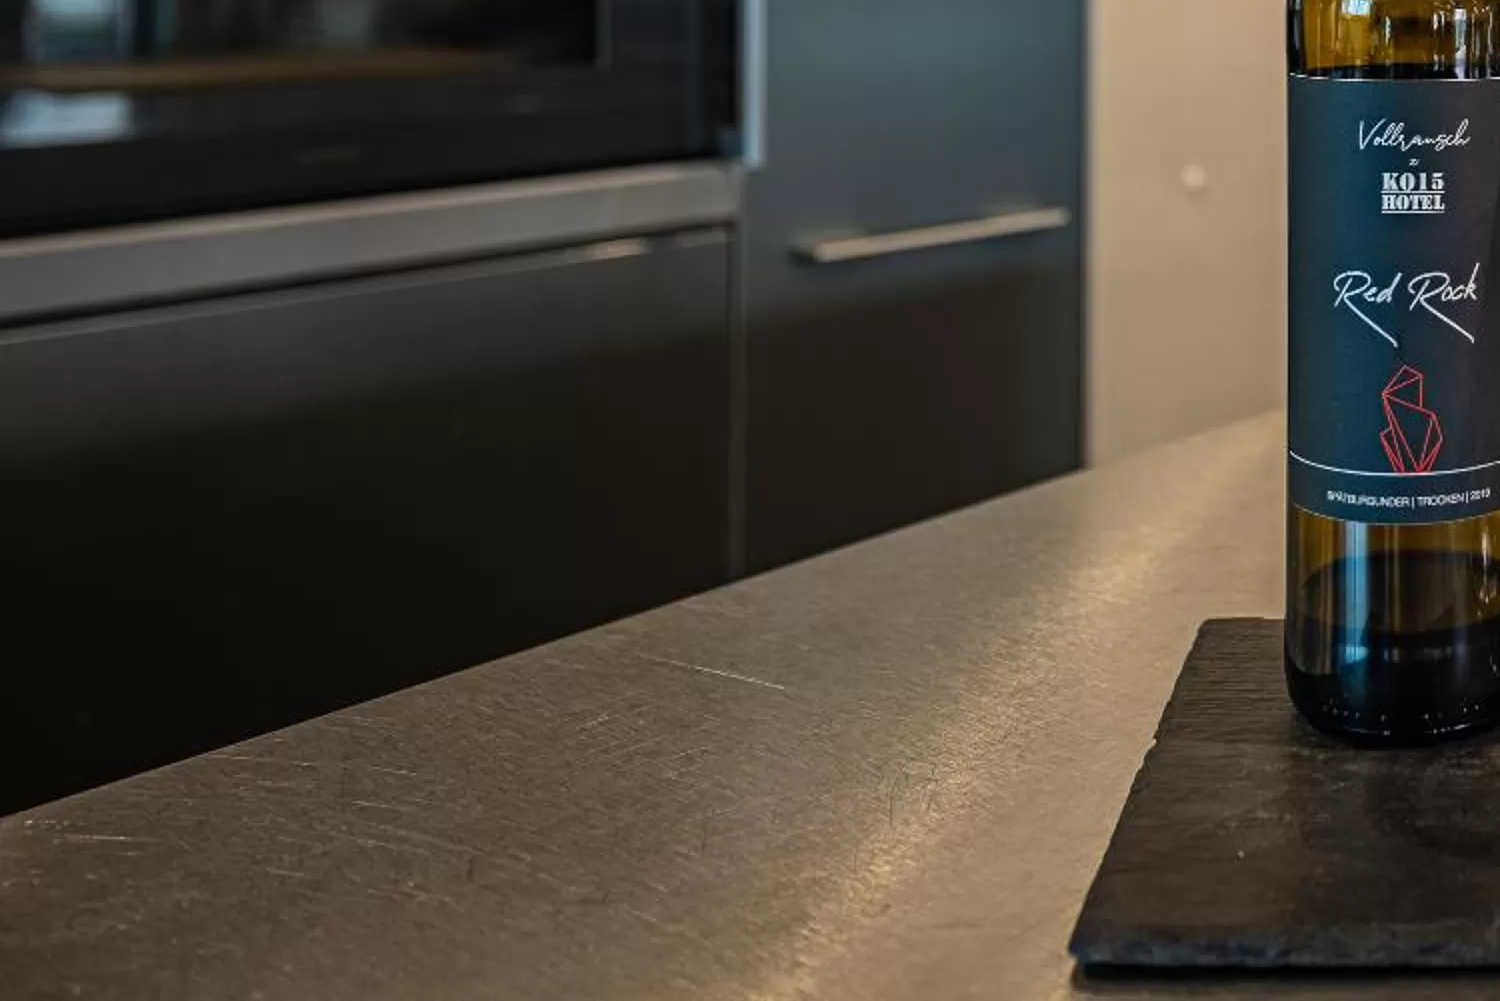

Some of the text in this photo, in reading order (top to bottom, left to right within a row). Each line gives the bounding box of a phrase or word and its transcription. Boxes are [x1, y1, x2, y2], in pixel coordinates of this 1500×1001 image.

[1381, 194, 1445, 210] HOTEL
[1333, 262, 1481, 348] Red Rock
[1417, 491, 1466, 508] TROCKEN
